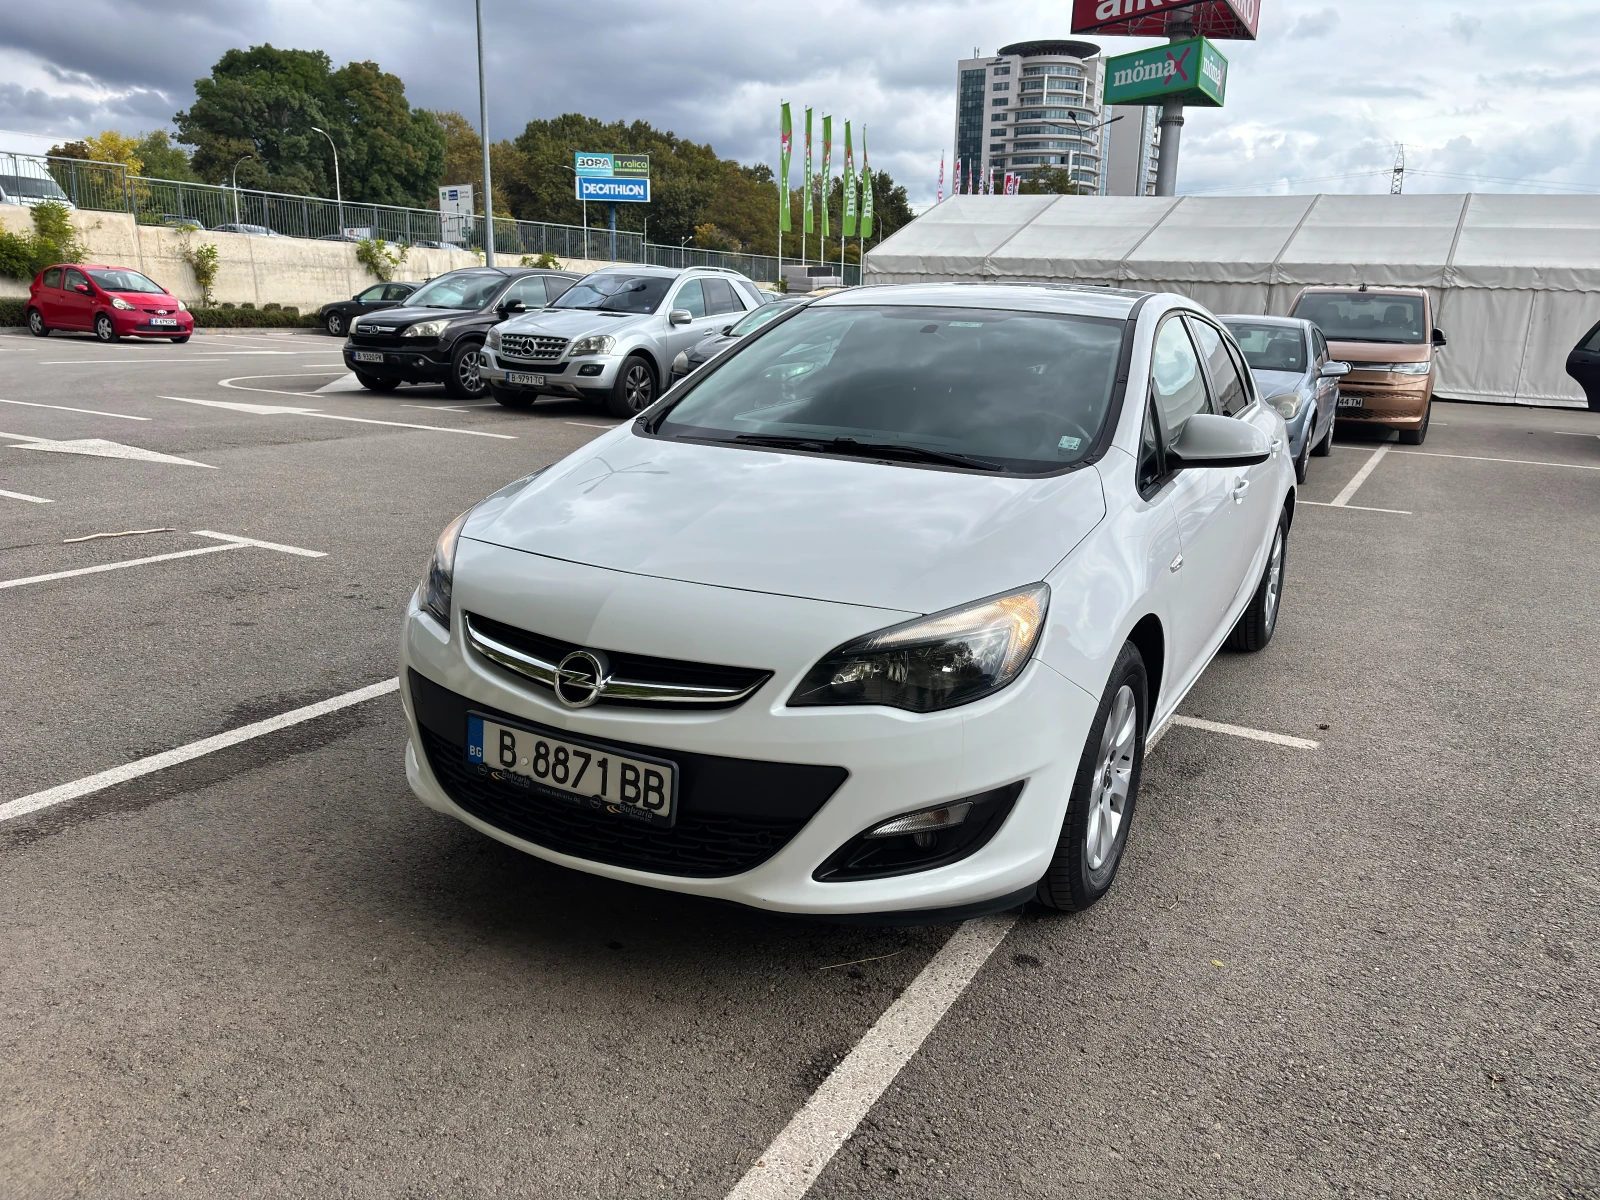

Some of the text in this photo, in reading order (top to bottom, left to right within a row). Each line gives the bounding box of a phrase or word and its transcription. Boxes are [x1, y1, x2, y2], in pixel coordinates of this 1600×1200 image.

[622, 160, 647, 168] ralica
[583, 183, 644, 195] DECATHLON
[511, 373, 516, 382] B
[469, 744, 482, 758] BG
[499, 728, 665, 811] B 8871 BB
[620, 802, 653, 819] Bulvaria
